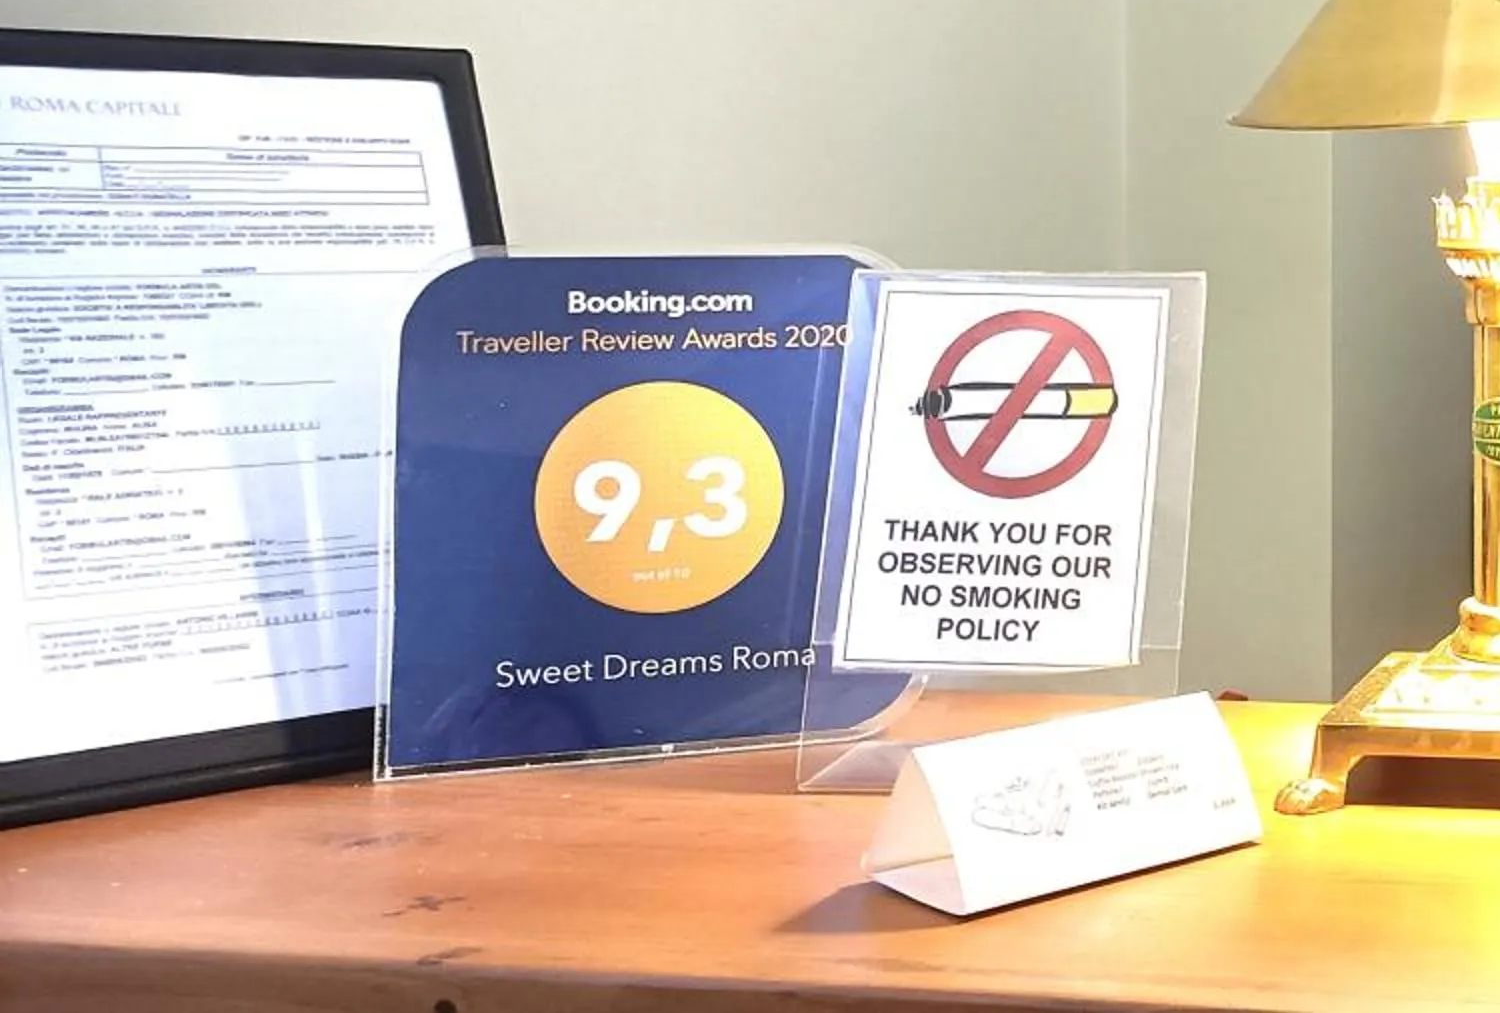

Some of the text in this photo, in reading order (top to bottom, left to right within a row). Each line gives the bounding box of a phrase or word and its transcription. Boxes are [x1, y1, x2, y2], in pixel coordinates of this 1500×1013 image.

[9, 95, 182, 117] ROMA CAPITALE
[568, 291, 752, 318] Booking.com
[457, 323, 853, 354] Traveller Review Awards 2020
[574, 456, 748, 552] 9,3
[884, 519, 1112, 547] THANK YOU FOR
[877, 551, 1112, 579] OBSERVING OUR
[901, 584, 1081, 611] NO SMOKING
[936, 618, 1040, 642] POLICY
[495, 645, 815, 688] Sweet Dreams Roma
